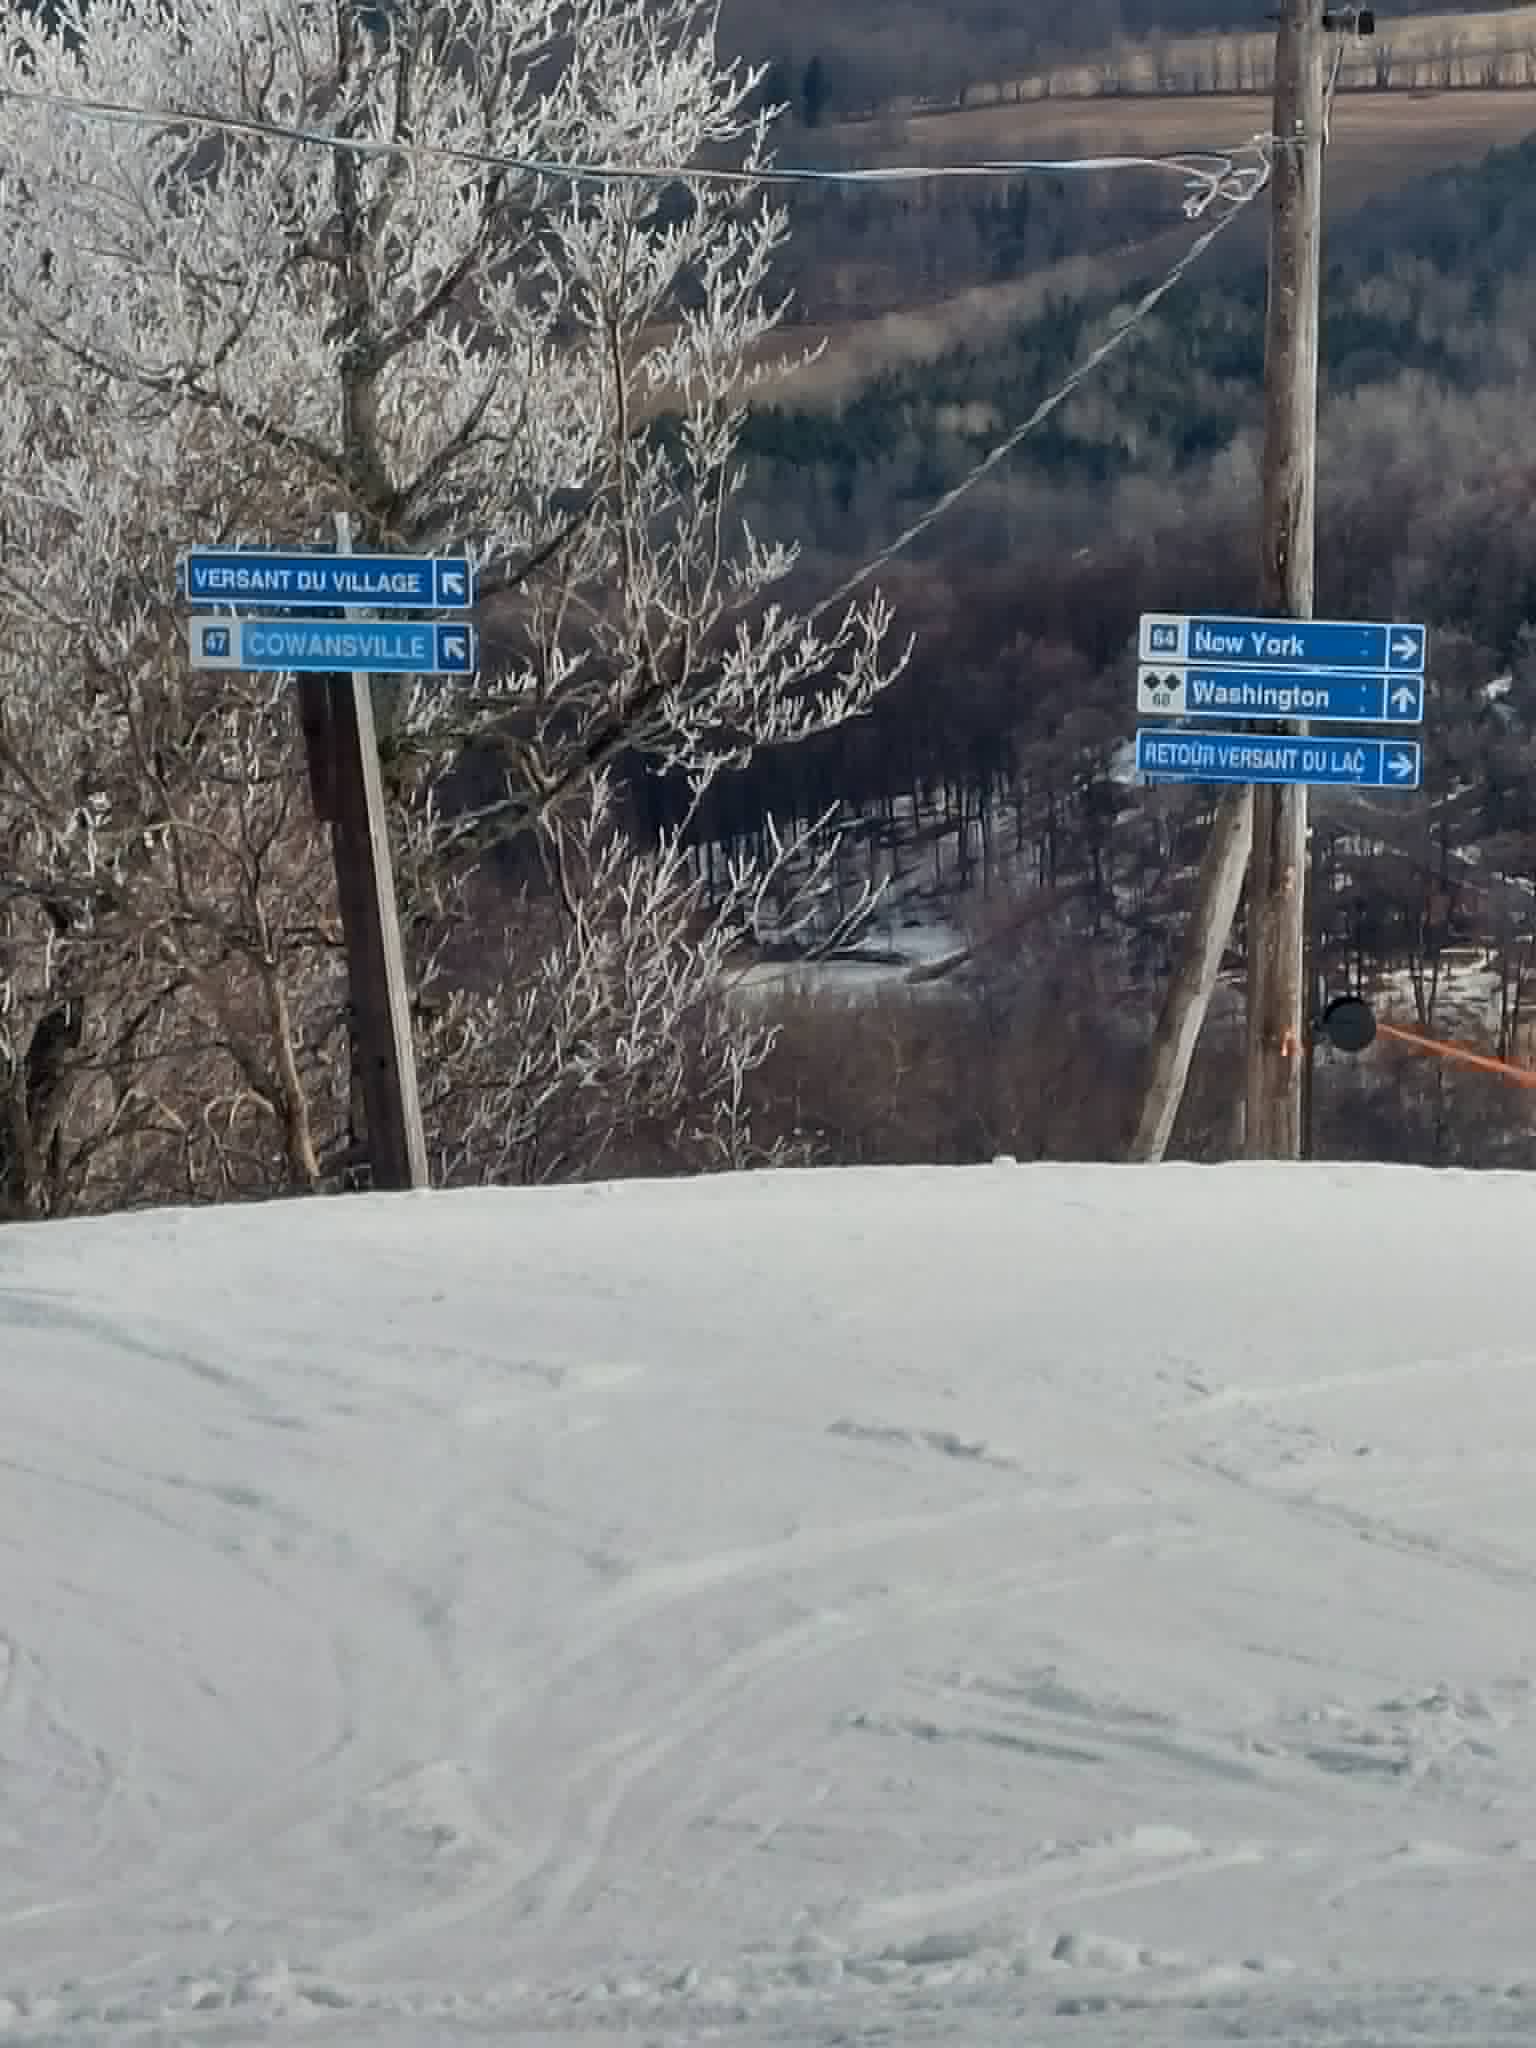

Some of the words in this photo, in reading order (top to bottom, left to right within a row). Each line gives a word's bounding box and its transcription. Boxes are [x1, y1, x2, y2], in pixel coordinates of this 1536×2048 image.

[194, 567, 291, 592] VERSANT
[297, 569, 327, 592] DU
[332, 570, 422, 593] VILLAGE
[248, 631, 425, 658] COWANSVILLE
[1195, 631, 1243, 654] New
[1251, 631, 1305, 657] York
[1192, 679, 1329, 711] Washington
[1144, 742, 1215, 767] RETOUR
[1217, 745, 1299, 770] VERSANT
[1303, 751, 1328, 772] DU
[1331, 750, 1366, 774] LAC
